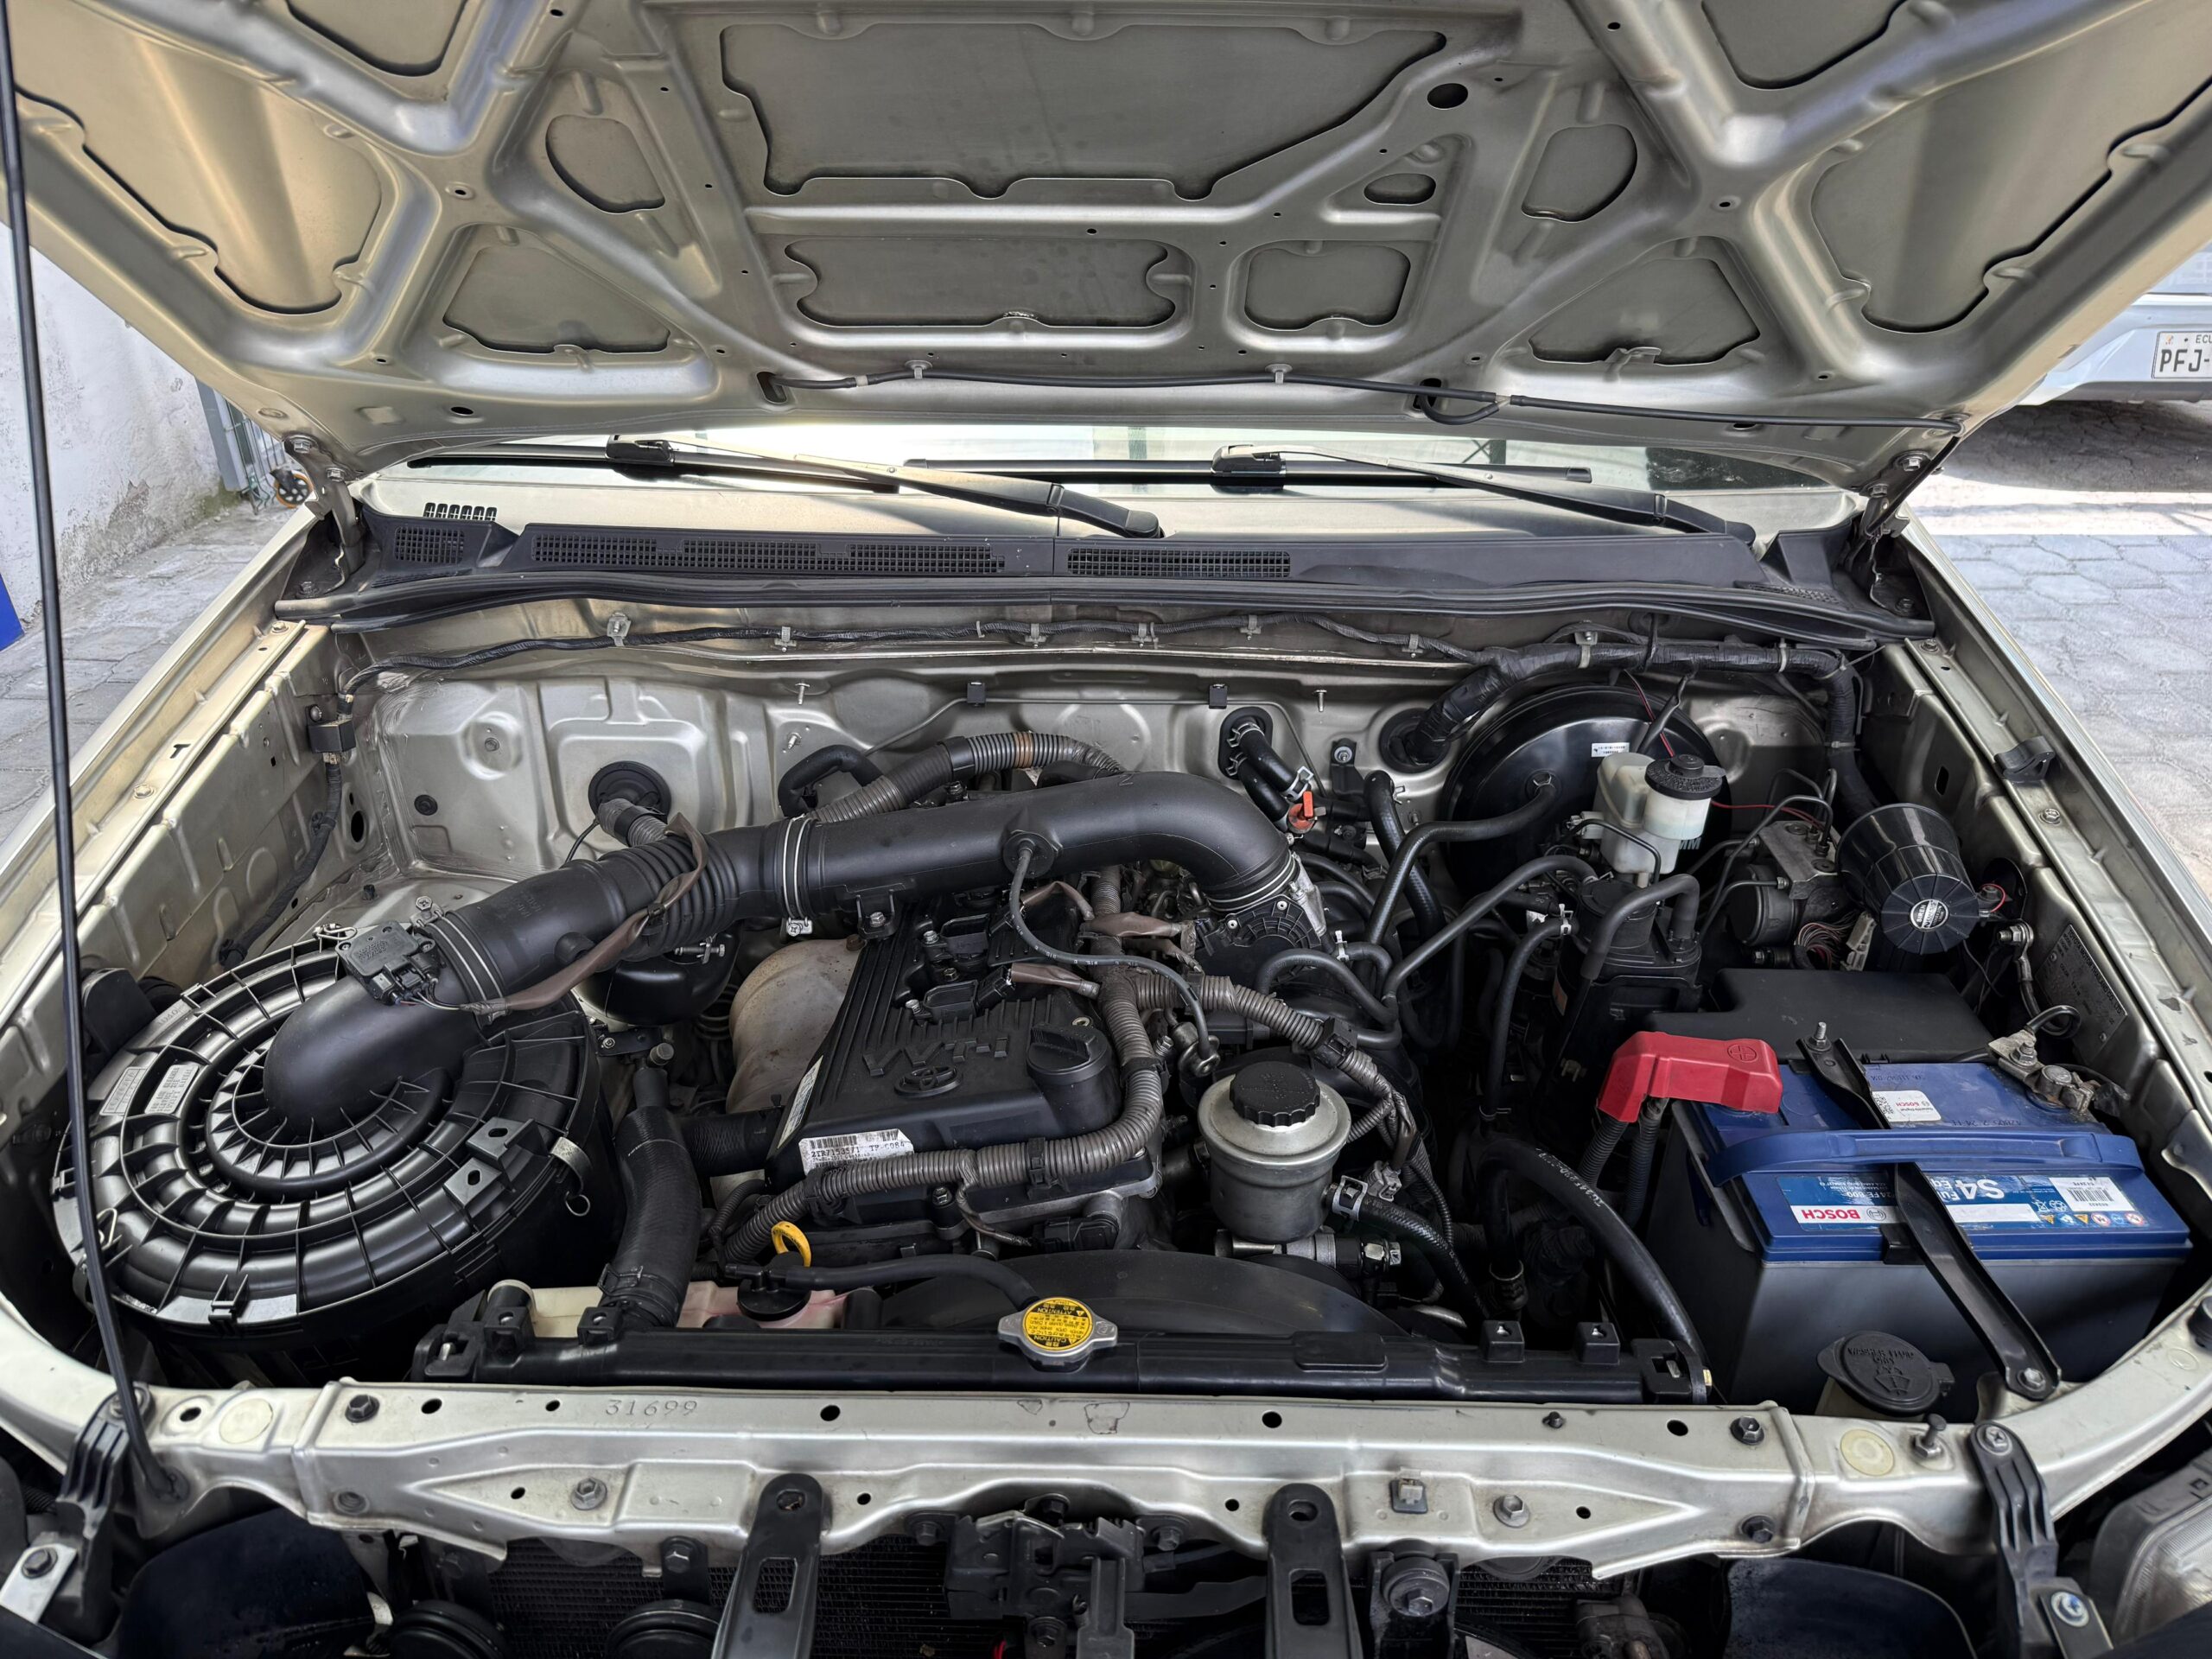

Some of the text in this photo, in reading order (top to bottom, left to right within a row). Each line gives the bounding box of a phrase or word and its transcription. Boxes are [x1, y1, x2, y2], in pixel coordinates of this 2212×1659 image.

[1955, 1179, 2005, 1200] S4
[1802, 1209, 1861, 1219] BOSCH
[1033, 1335, 1067, 1344] CAUTION
[1847, 1347, 1885, 1357] WASHER
[606, 1399, 698, 1416] 31699
